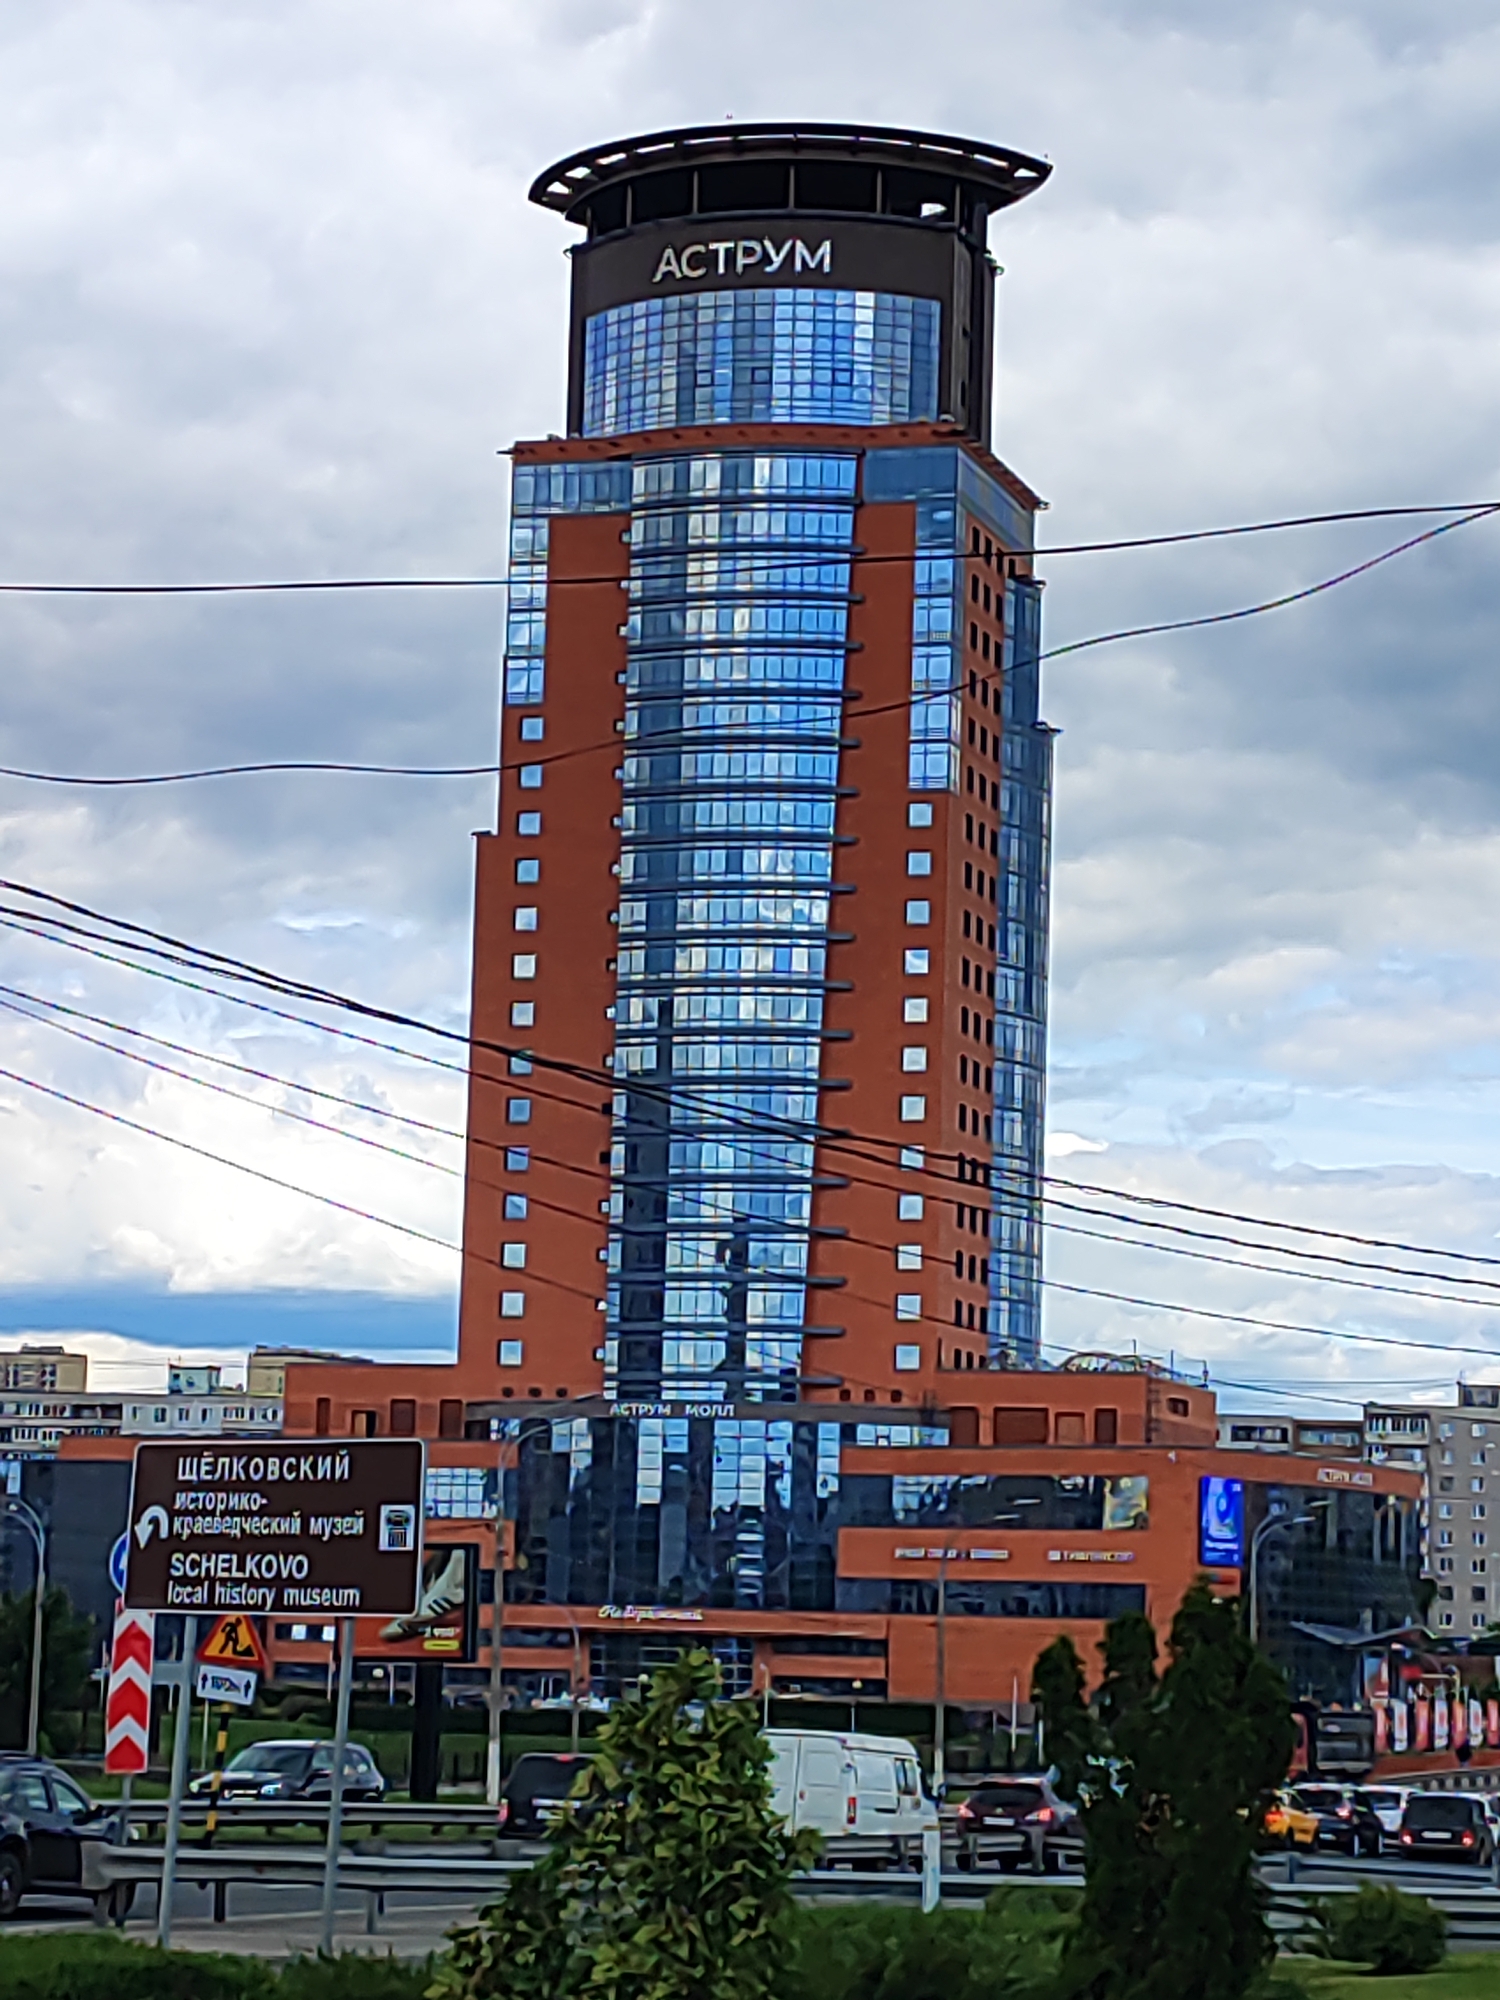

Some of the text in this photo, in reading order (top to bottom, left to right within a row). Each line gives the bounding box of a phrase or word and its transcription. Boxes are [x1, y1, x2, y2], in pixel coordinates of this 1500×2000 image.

[651, 236, 832, 283] АСТРУМ
[609, 1402, 736, 1417] АСТРУМ МОЛЛ
[177, 1450, 350, 1484] ЩЁЛКОВСКИЙ
[173, 1491, 268, 1514] историко-
[173, 1510, 365, 1541] краеведческий музей
[169, 1552, 309, 1580] SCHELKOVO
[167, 1581, 361, 1611] local history museum
